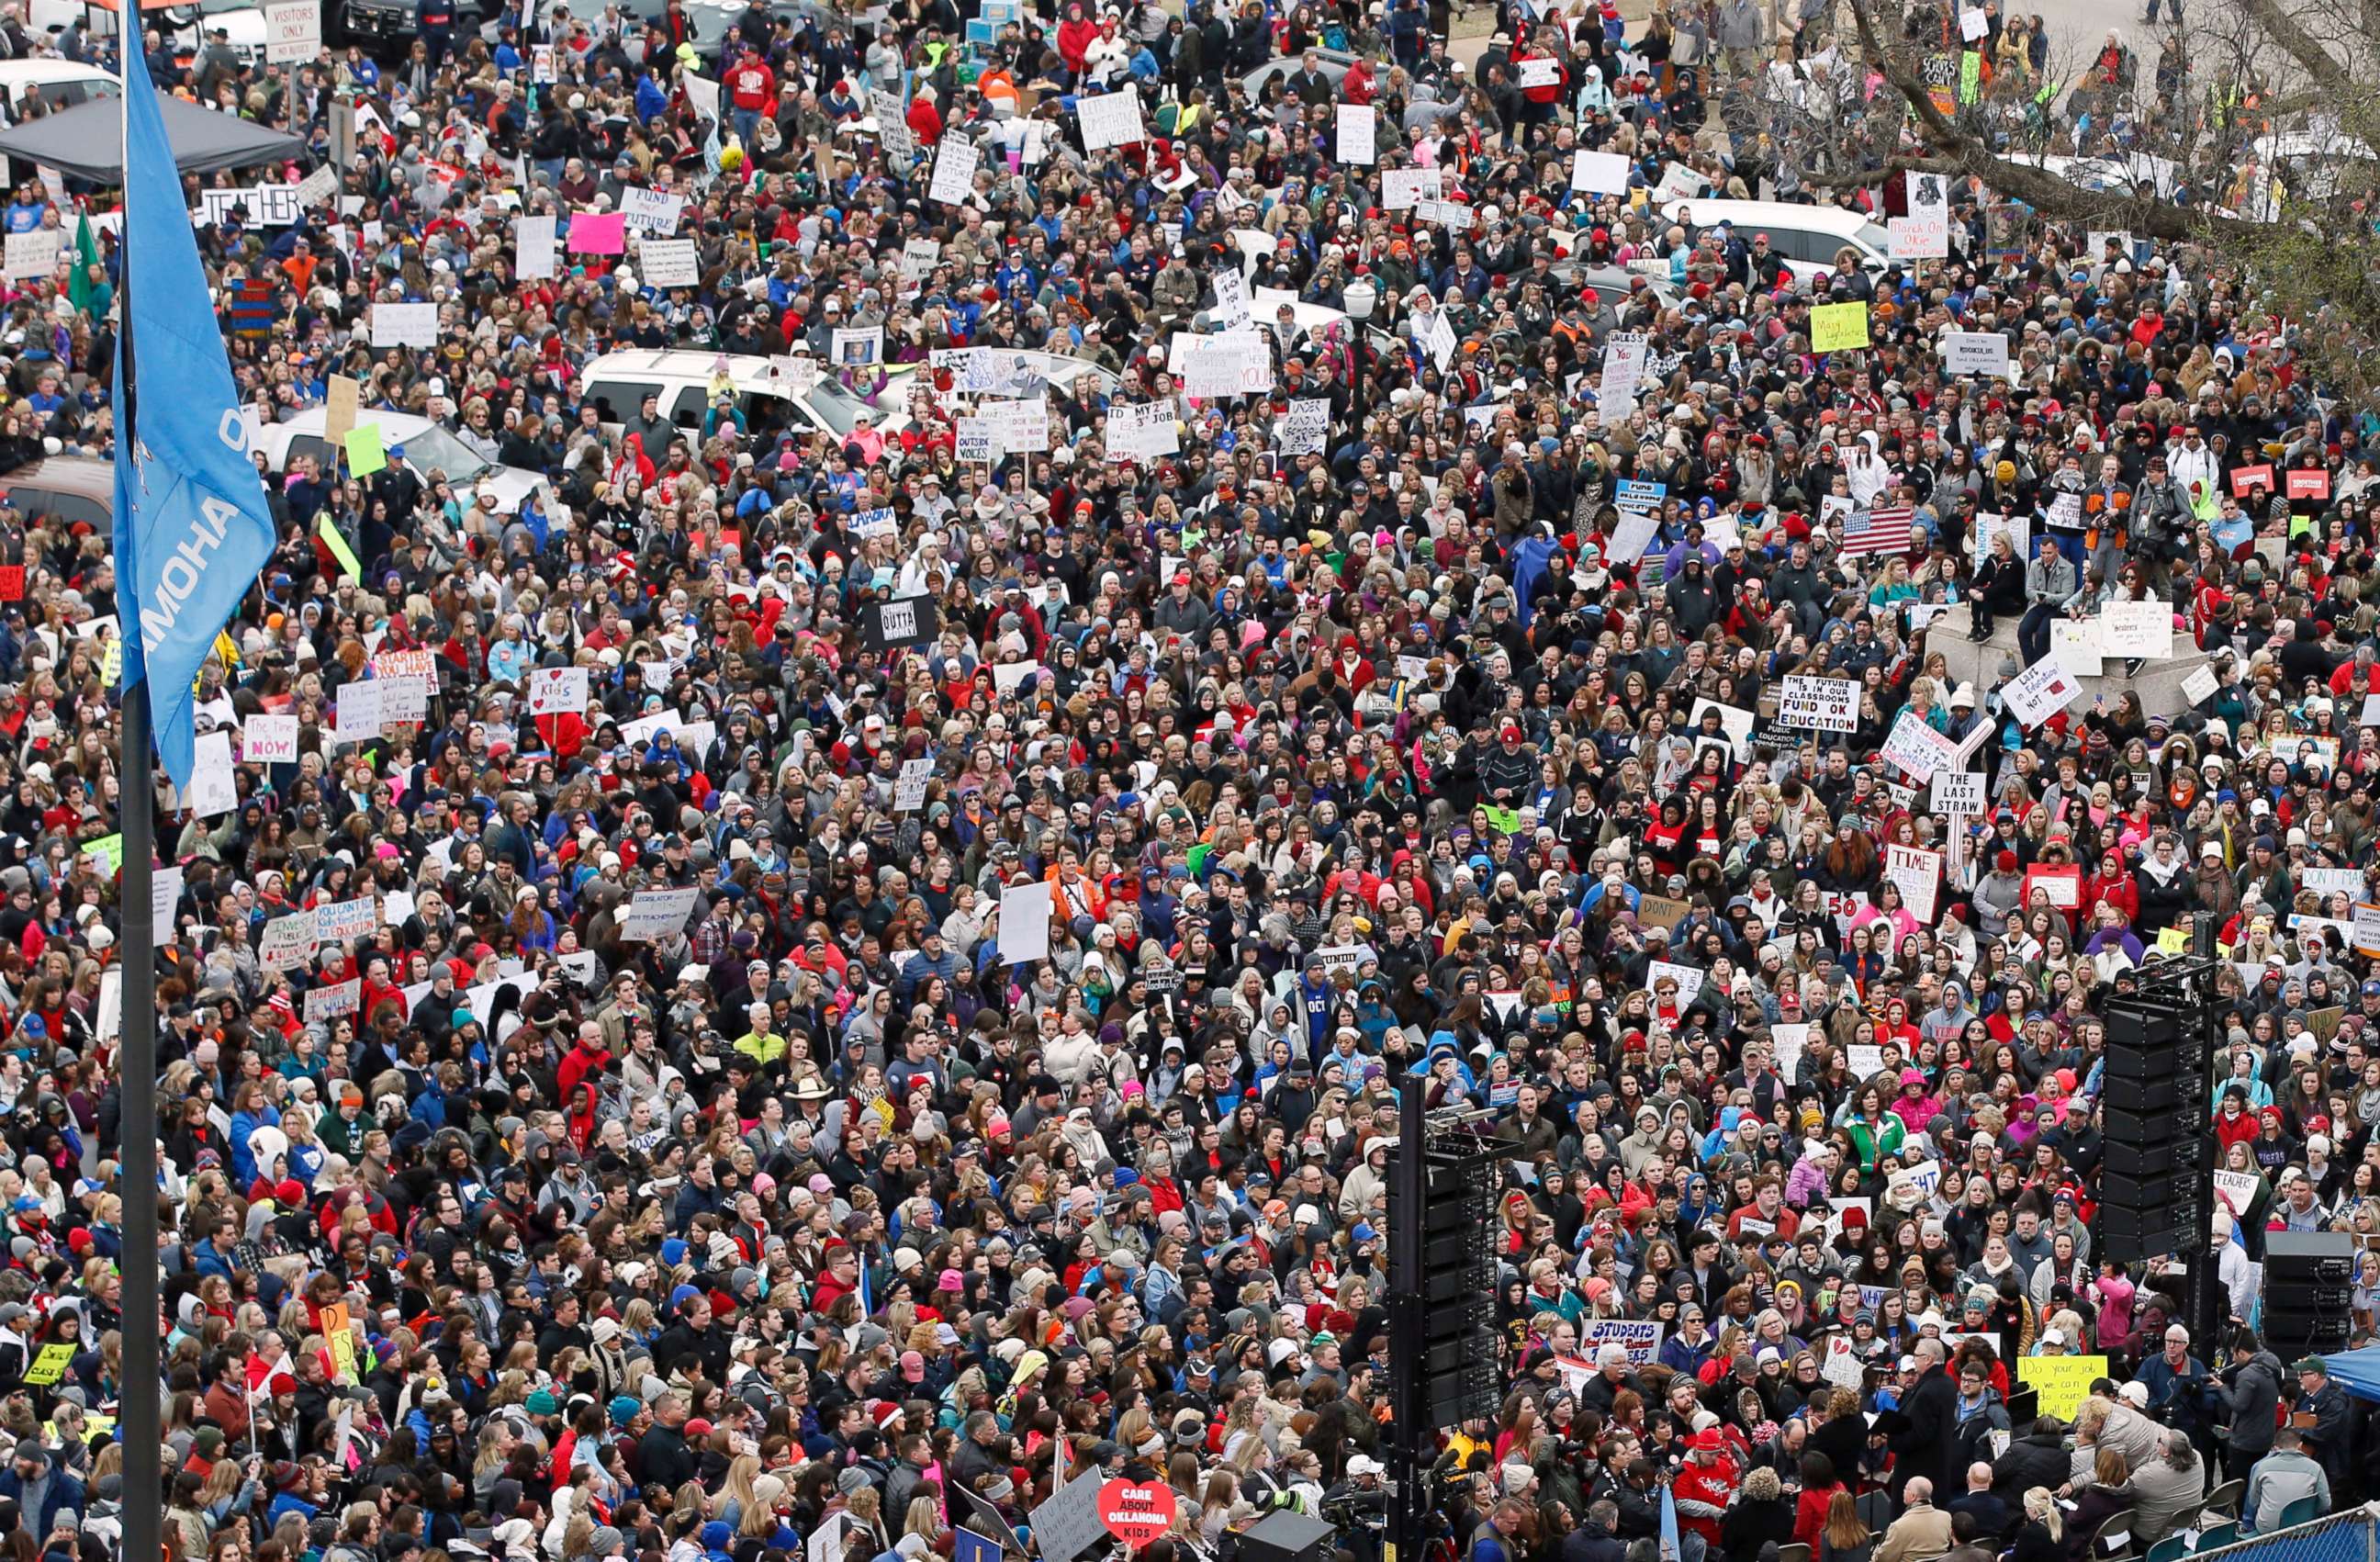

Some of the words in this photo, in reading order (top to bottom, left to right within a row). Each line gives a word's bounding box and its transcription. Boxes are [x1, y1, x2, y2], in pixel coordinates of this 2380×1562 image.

[275, 7, 314, 23] VISITORS
[283, 25, 304, 39] ONLY
[636, 190, 669, 205] FUND
[624, 213, 672, 230] FUTURE
[1890, 221, 1923, 234] March
[1928, 221, 1942, 233] On
[1135, 406, 1150, 418] MY
[1151, 411, 1173, 424] JOB
[959, 438, 991, 447] OUTSIDE
[960, 449, 988, 459] VOICES
[2237, 474, 2266, 486] TOGETHER
[2293, 479, 2322, 489] TOGETHER
[882, 612, 914, 630] OUTTA
[379, 650, 430, 667] STARTED
[1787, 677, 1804, 686] THE
[1815, 679, 1850, 689] FUTURE
[1799, 683, 1807, 691] IS
[1829, 687, 1847, 695] OUR
[1787, 691, 1850, 703] CLASSROOMS
[2026, 694, 2043, 711] NOT
[1783, 698, 1818, 713] FUND
[1829, 703, 1847, 716] OK
[249, 718, 267, 734] The
[1780, 713, 1855, 731] EDUCATION
[1767, 725, 1791, 735] PUBLIC
[252, 740, 295, 756] NOW!
[1948, 773, 1970, 785] THE
[1943, 787, 1975, 799] LAST
[1937, 800, 1978, 813] STRAW
[1893, 850, 1932, 871] TIME
[2258, 1152, 2285, 1164] TIGERS
[2214, 1172, 2252, 1189] TEACHERS
[1592, 1322, 1655, 1338] STUDENTS
[2023, 1359, 2042, 1376] Do
[2052, 1365, 2072, 1378] your
[2079, 1363, 2095, 1379] job
[2044, 1380, 2056, 1389] we
[2060, 1380, 2080, 1389] can
[1121, 1488, 1152, 1501] CARE
[1118, 1500, 1155, 1512] ABOUT
[1107, 1511, 1167, 1524] OKLAHOMA
[1123, 1526, 1151, 1539] KIDS
